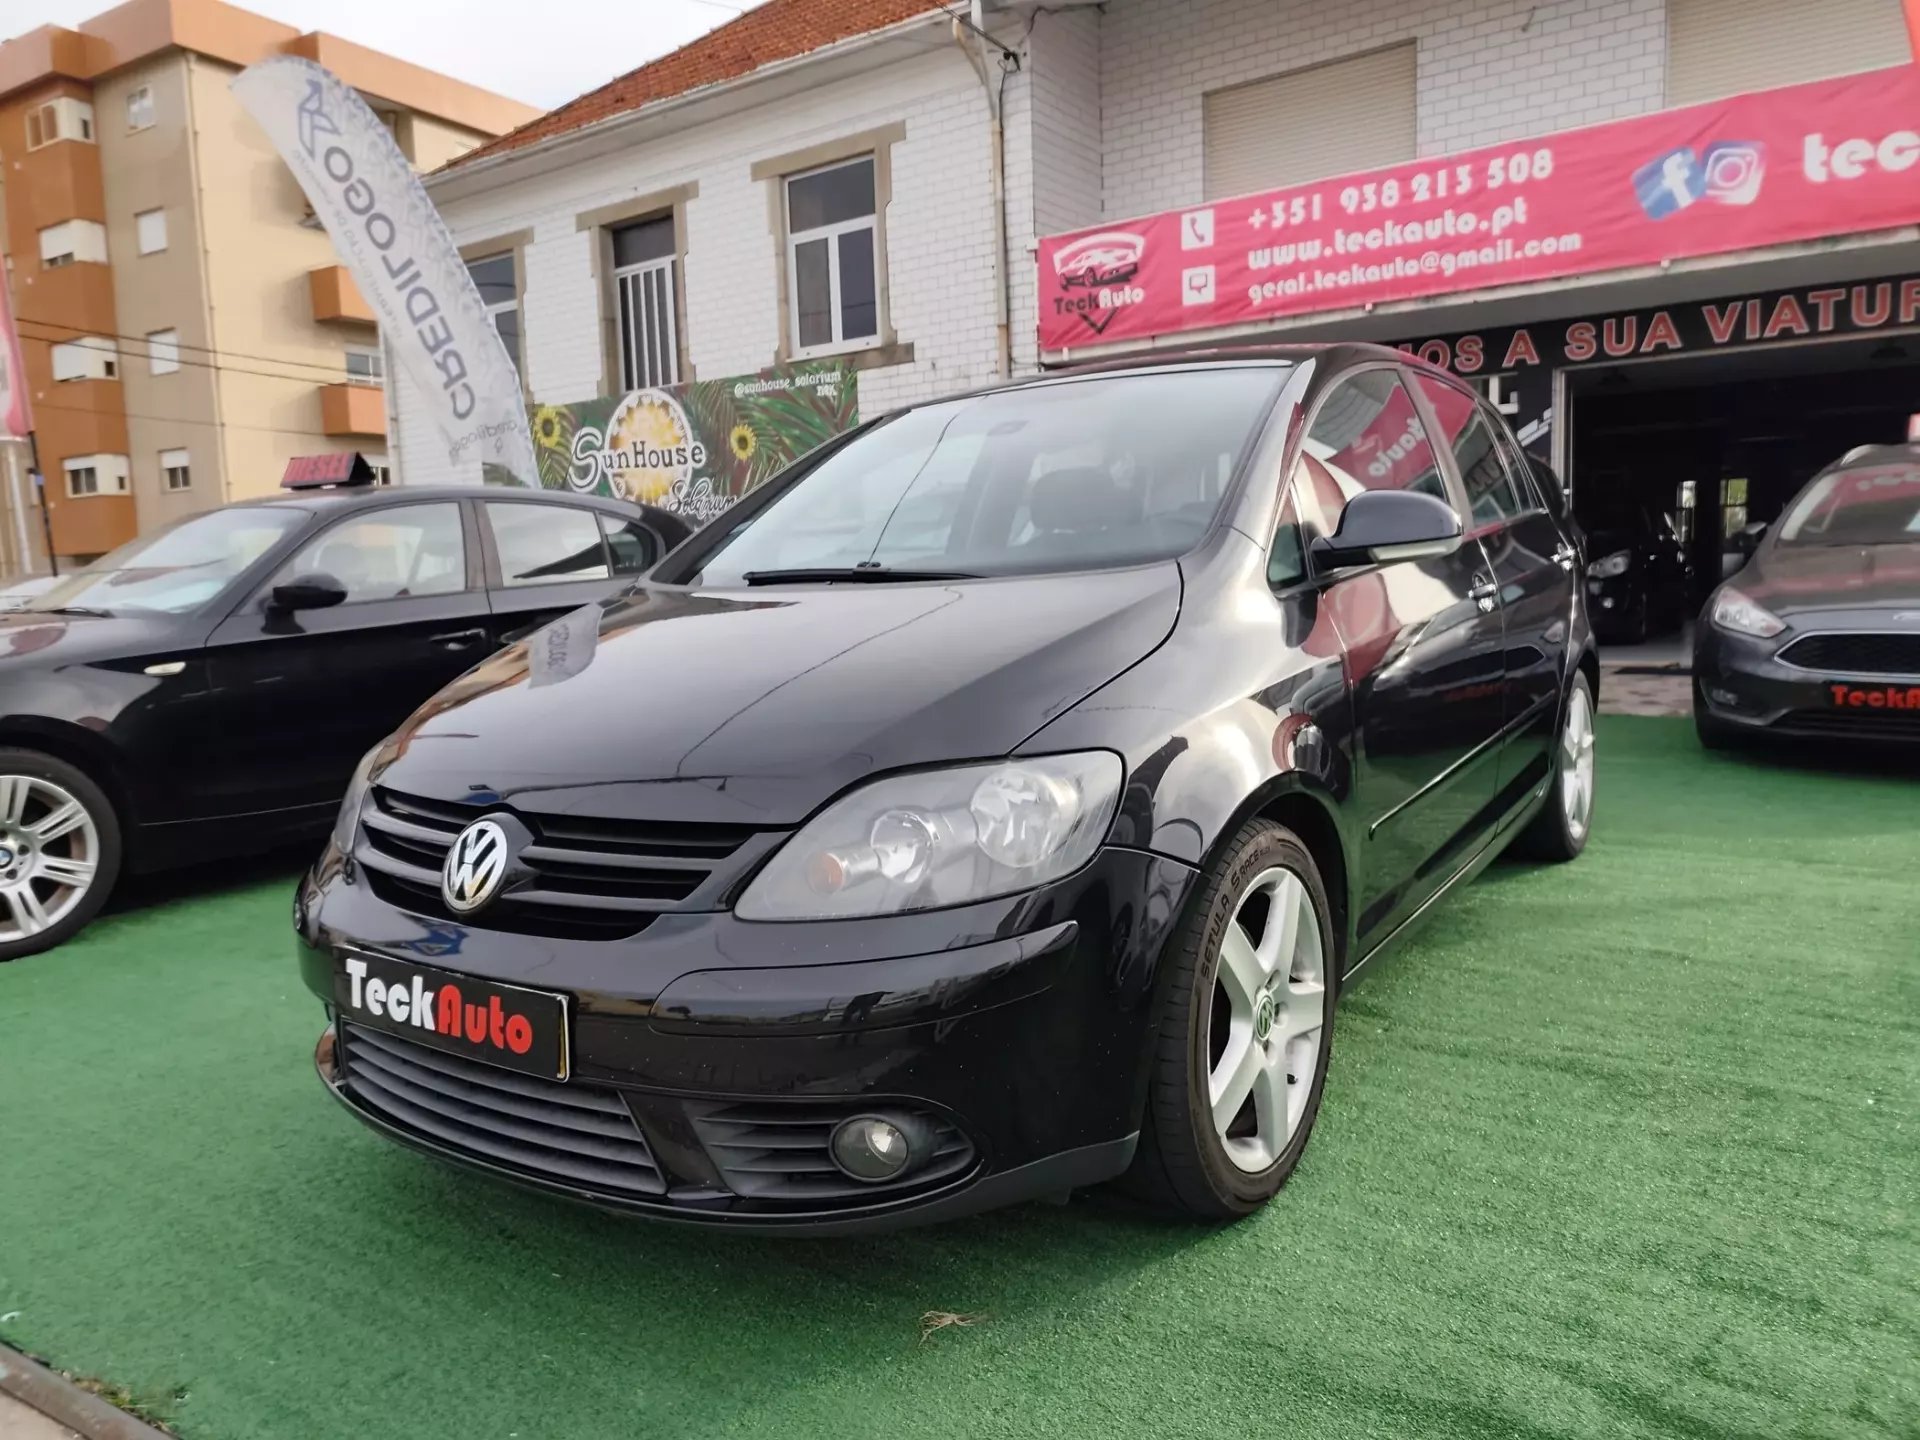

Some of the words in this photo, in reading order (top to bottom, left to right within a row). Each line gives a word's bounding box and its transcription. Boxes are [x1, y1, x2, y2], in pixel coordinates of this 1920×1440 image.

[1247, 194, 1322, 230] +351
[1340, 179, 1400, 214] 938
[1411, 164, 1473, 203] 213
[1487, 149, 1554, 189] 508
[1803, 130, 1920, 183] tec
[1247, 196, 1528, 270] www.teckauto.pt
[1248, 232, 1583, 306] geral.teckauto@gmail.com
[1053, 285, 1145, 315] TeckAuto
[1501, 329, 1540, 368] A
[1564, 311, 1683, 362] SUA
[567, 427, 707, 493] SunHouse
[1201, 893, 1230, 980] SETULA
[345, 958, 533, 1055] TeckAuto
